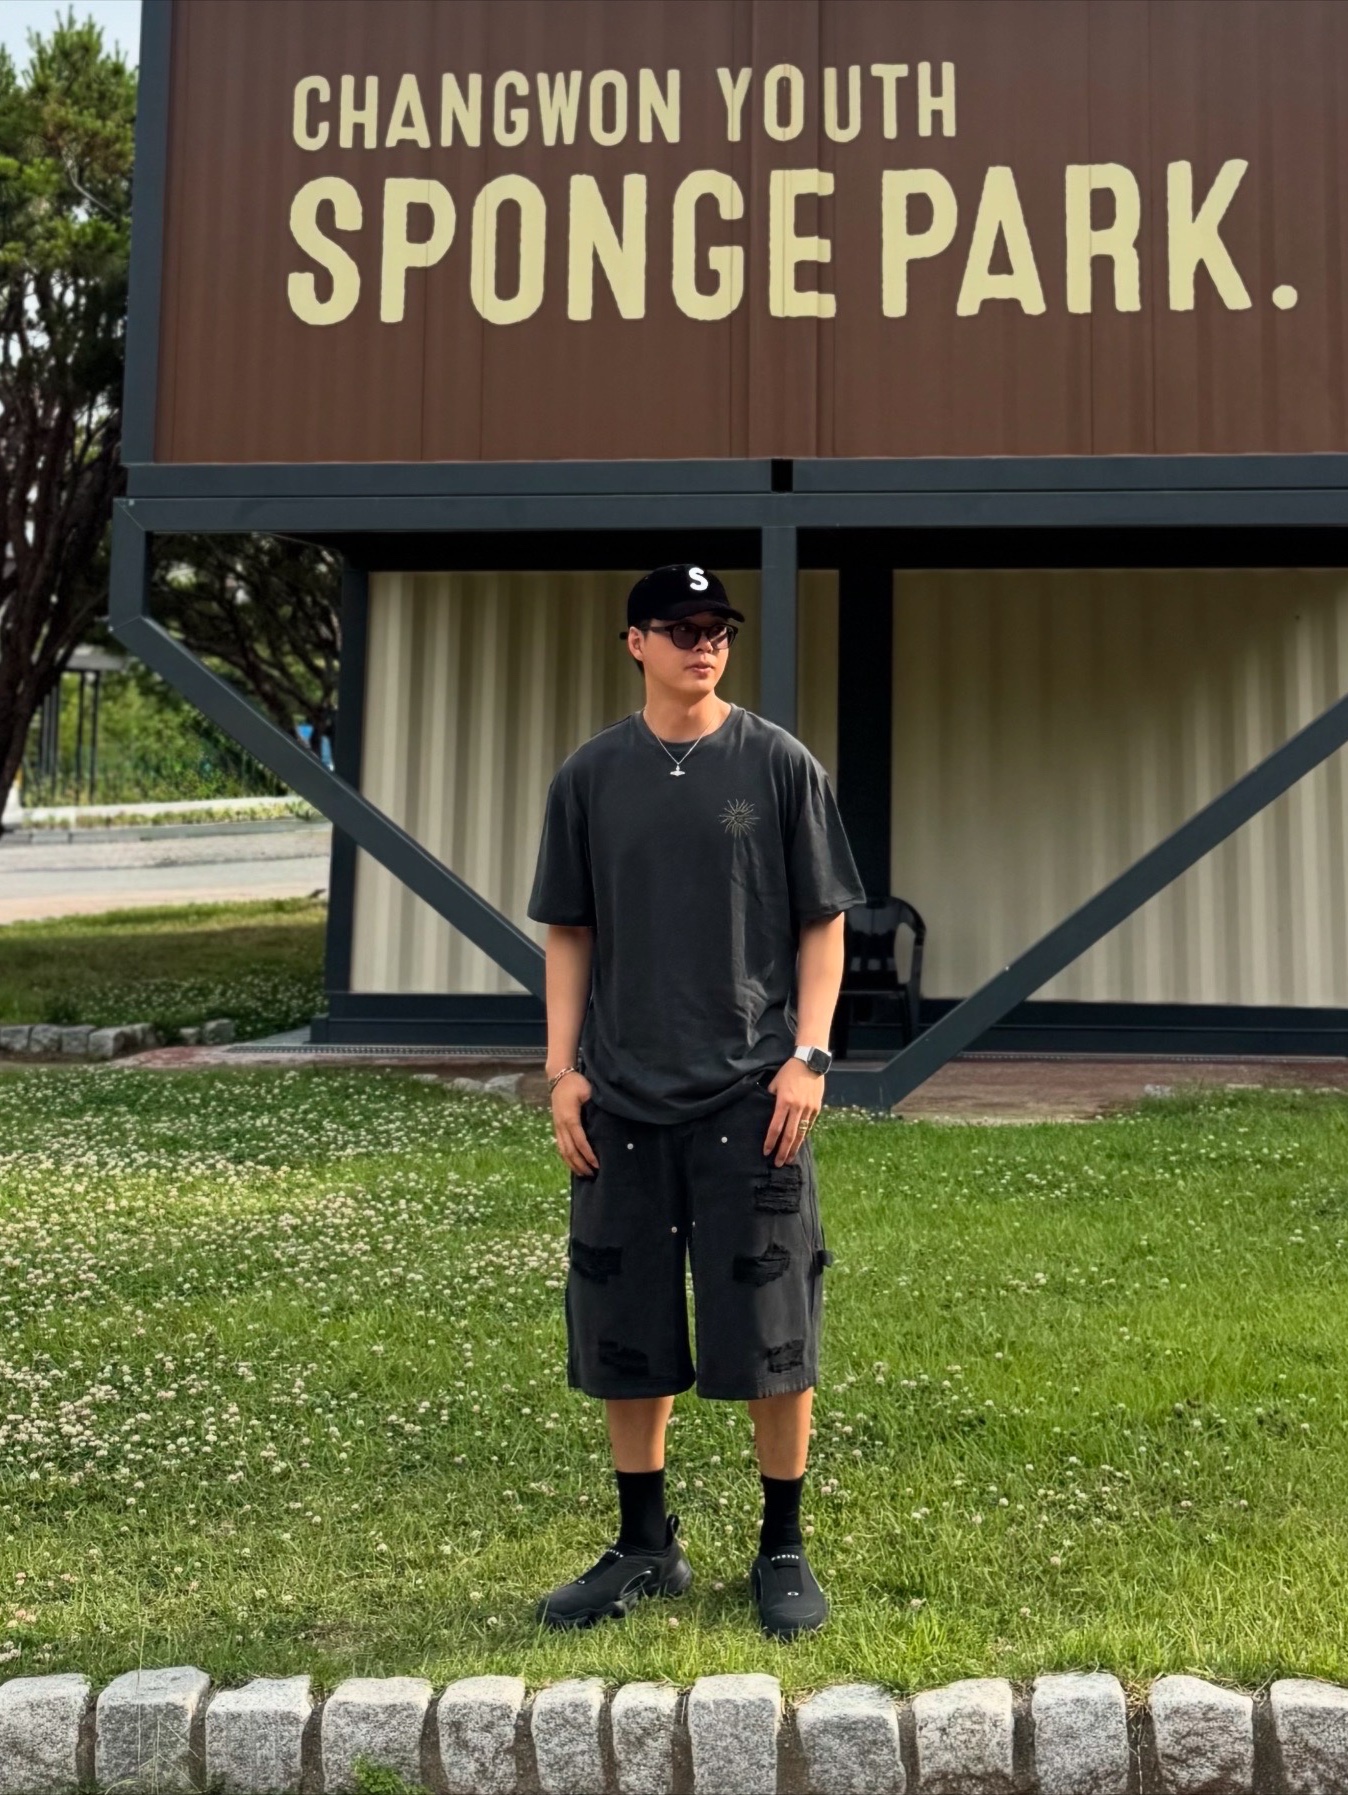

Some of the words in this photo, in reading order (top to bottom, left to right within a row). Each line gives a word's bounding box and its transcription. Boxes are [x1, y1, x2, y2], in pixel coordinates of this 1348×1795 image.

[292, 67, 682, 151] CHANGWON
[716, 61, 957, 144] YOUTH
[286, 167, 838, 327] SPONGE
[880, 158, 1299, 319] PARK.
[688, 566, 709, 591] S
